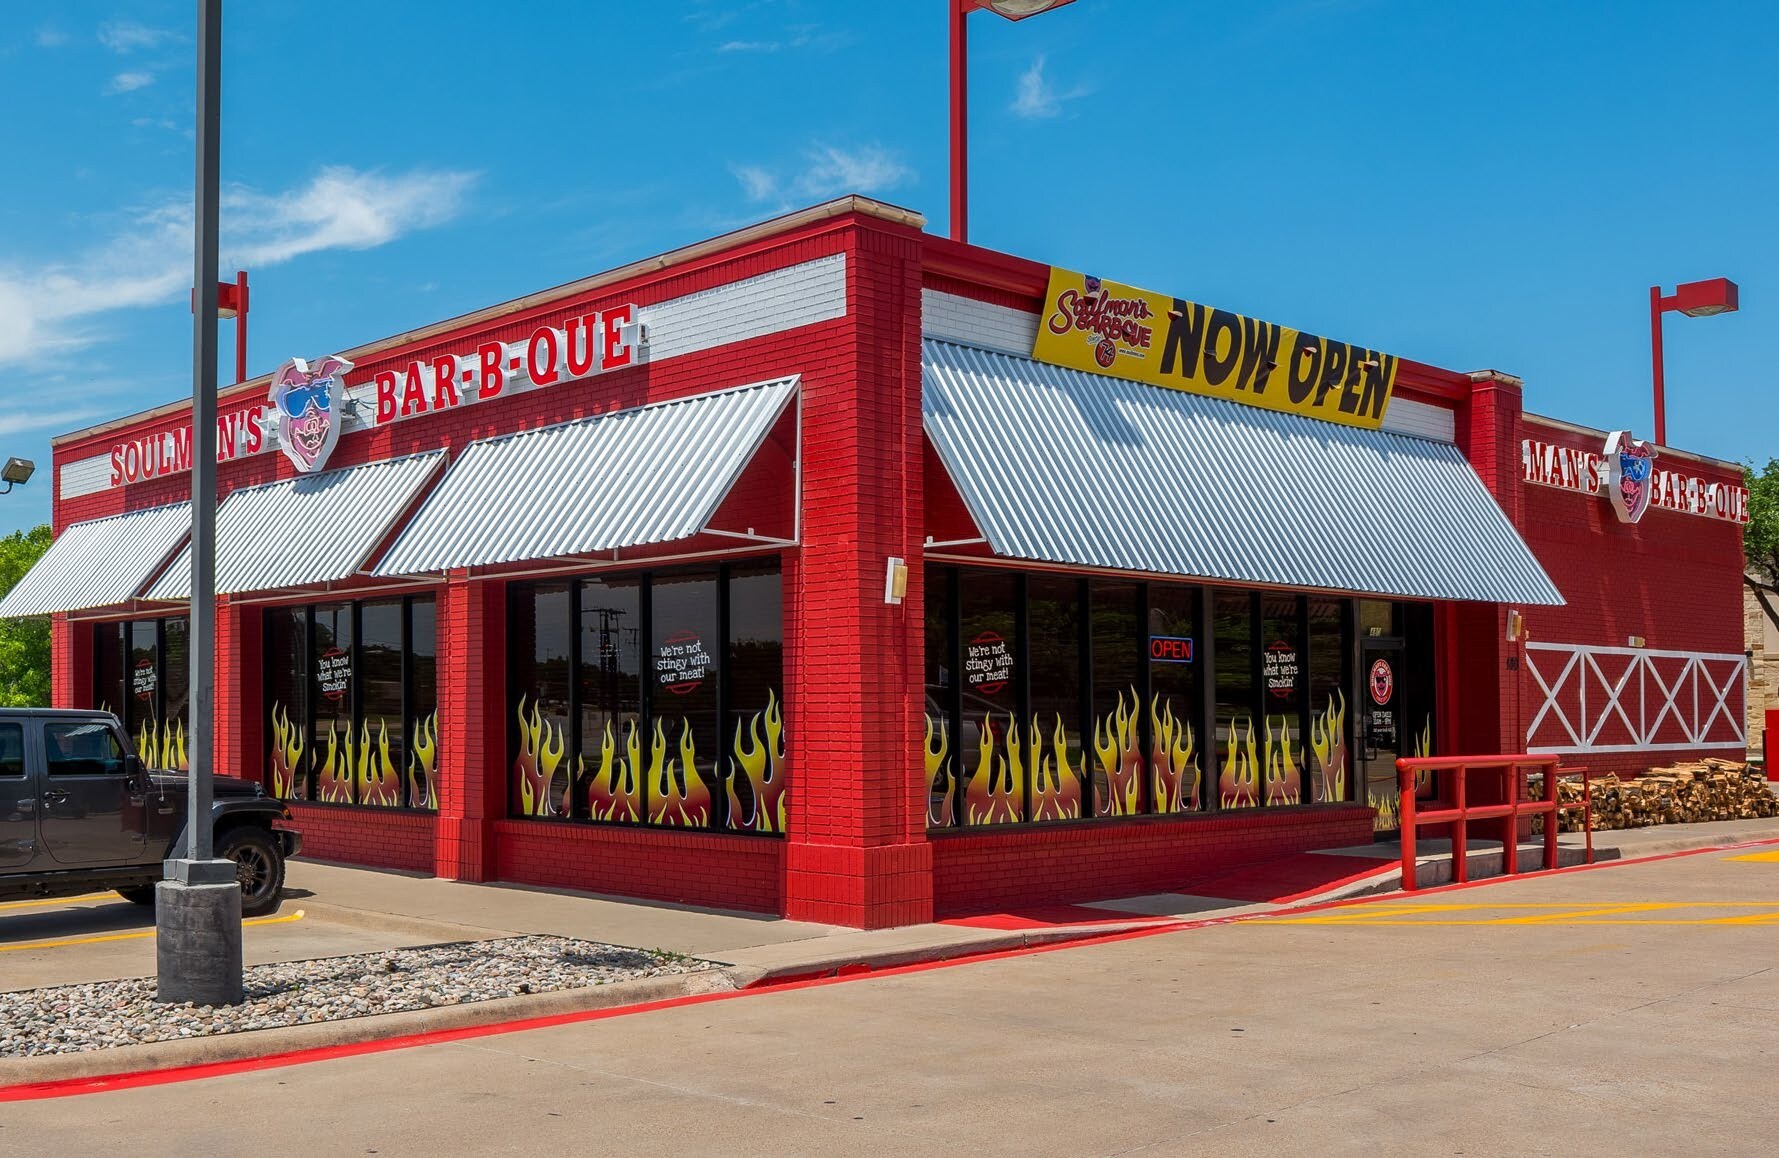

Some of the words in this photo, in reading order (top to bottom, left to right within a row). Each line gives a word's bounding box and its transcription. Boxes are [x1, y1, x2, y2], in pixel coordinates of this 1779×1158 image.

[1049, 290, 1154, 335] Soulman's
[1160, 298, 1281, 395] NOW
[1288, 331, 1394, 420] OPEN
[111, 405, 262, 487] SOULMN'S
[374, 303, 632, 426] BAR-B-QUE
[1522, 439, 1599, 494] MAN'S
[1650, 467, 1750, 523] BAR-B-QUE
[661, 646, 684, 657] We're
[686, 640, 701, 654] not
[969, 645, 990, 657] We're
[992, 641, 1005, 654] not
[1152, 640, 1191, 659] OPEN
[1264, 652, 1277, 663] You
[1278, 650, 1295, 662] know
[318, 660, 330, 670] You
[331, 656, 349, 667] know
[657, 658, 687, 671] stingy
[690, 652, 710, 666] with
[966, 658, 993, 671] stingy
[995, 653, 1013, 667] with
[1264, 663, 1278, 675] what
[1280, 664, 1298, 674] we're
[317, 669, 332, 681] what
[334, 668, 351, 678] we're
[660, 673, 677, 683] our
[680, 666, 704, 680] meat!
[969, 673, 984, 683] our
[986, 667, 1009, 681] meat!
